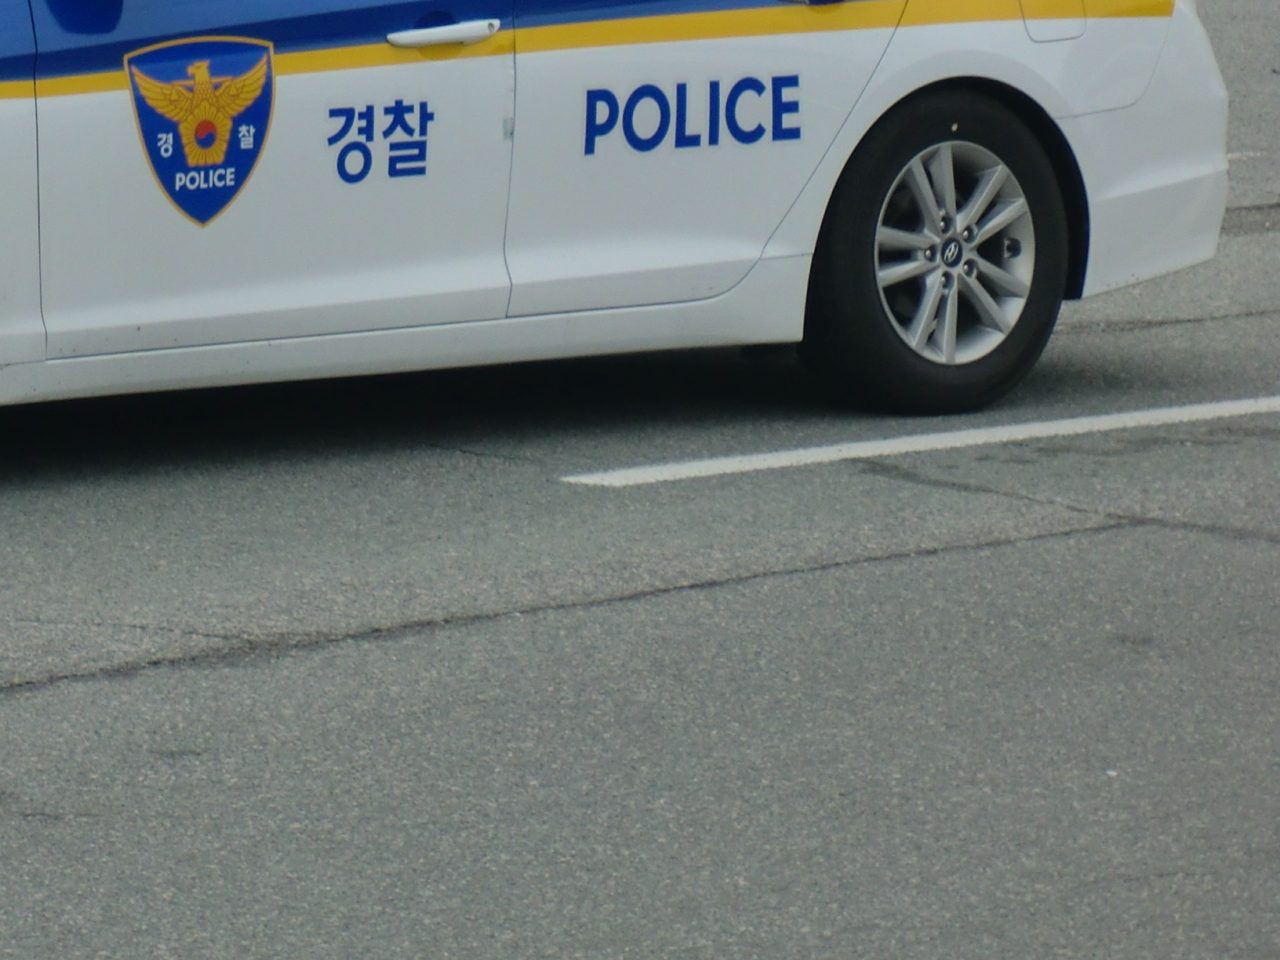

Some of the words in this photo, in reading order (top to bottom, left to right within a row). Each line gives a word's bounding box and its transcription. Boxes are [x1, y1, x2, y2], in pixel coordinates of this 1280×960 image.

[157, 132, 173, 158] 경
[238, 124, 256, 150] 찰
[327, 99, 434, 185] 경찰
[584, 74, 801, 156] POLICE
[175, 167, 236, 192] POLICE
